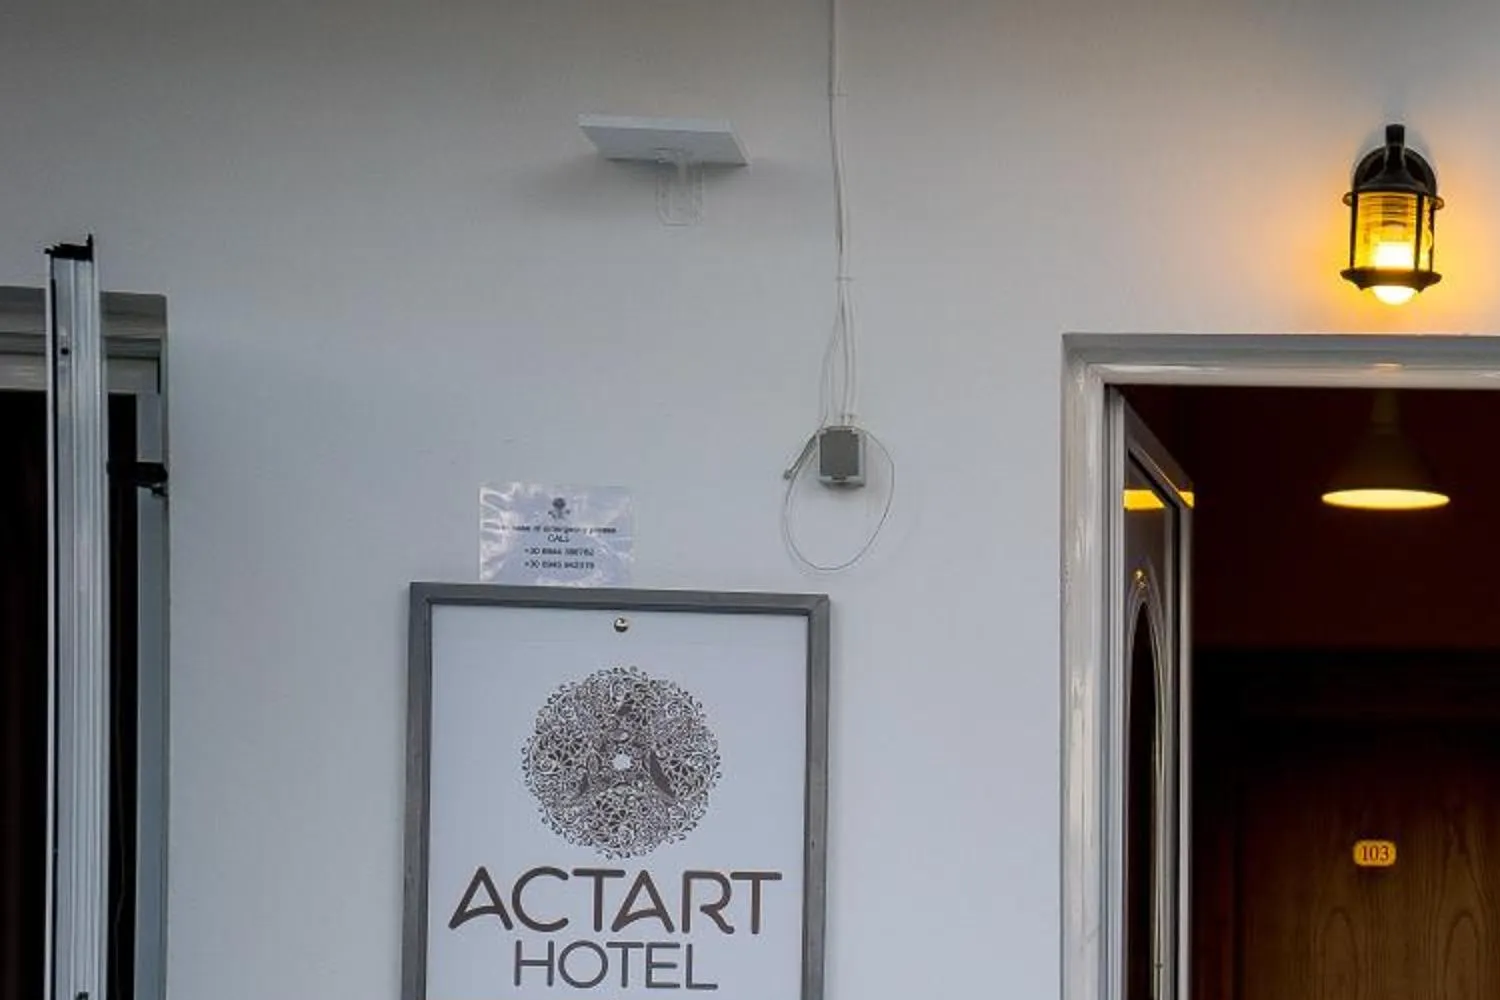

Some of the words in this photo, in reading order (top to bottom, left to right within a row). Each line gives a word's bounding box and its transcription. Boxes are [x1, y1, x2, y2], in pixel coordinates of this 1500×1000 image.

[1362, 846, 1389, 861] 103
[448, 865, 783, 935] ACTART
[513, 939, 719, 990] HOTEL
